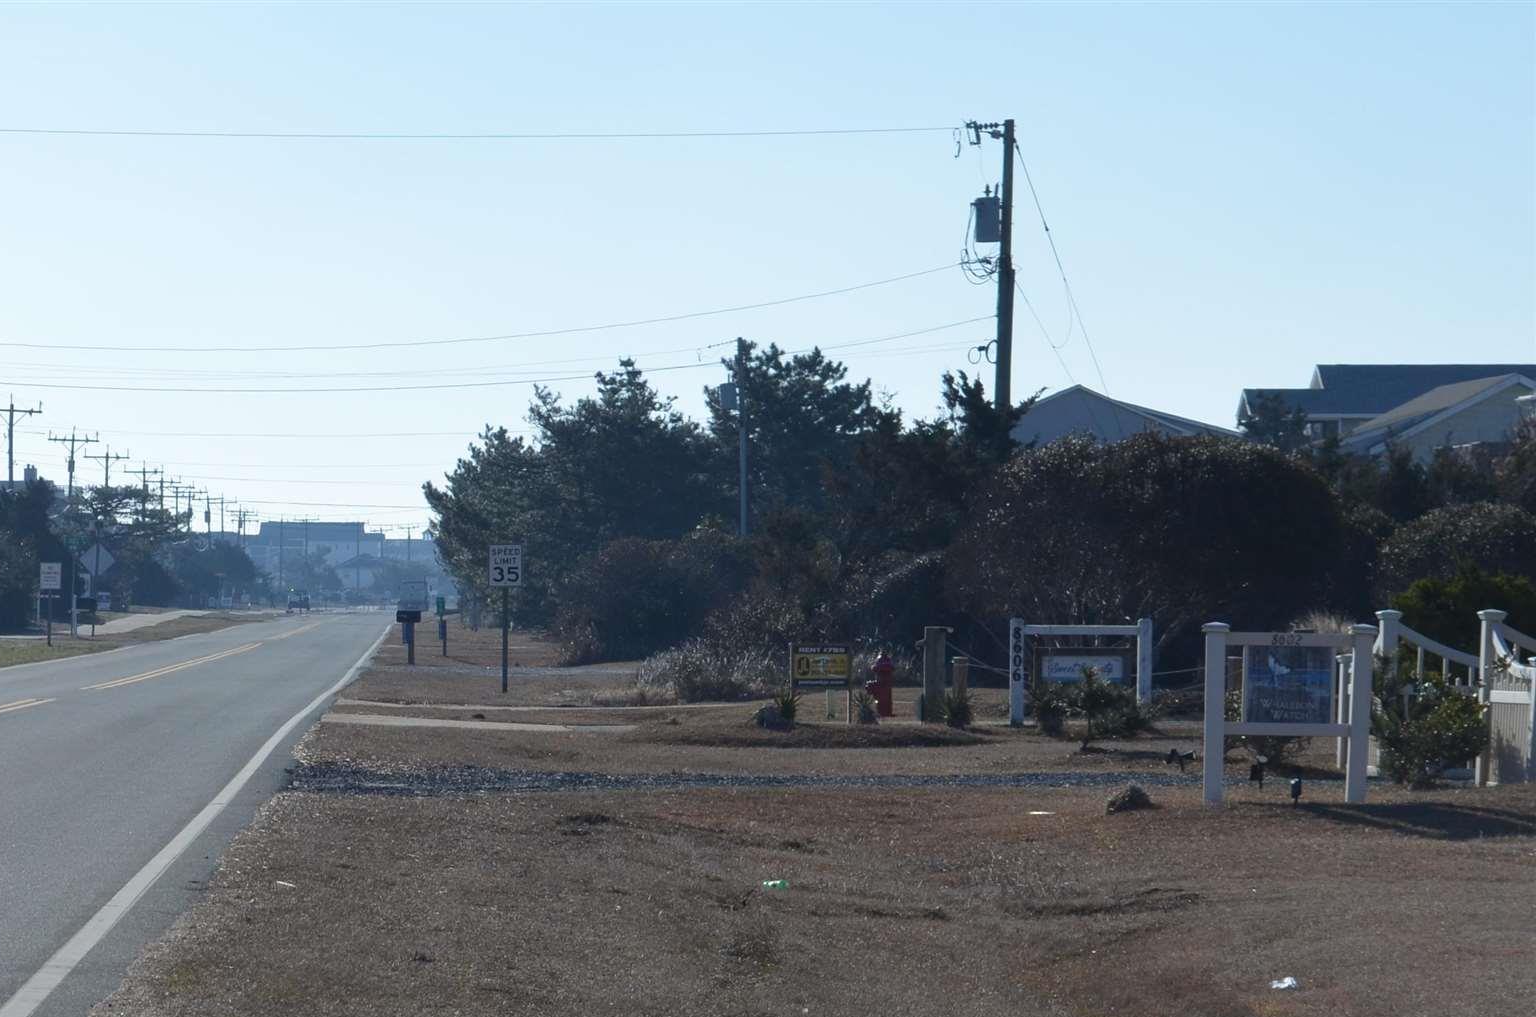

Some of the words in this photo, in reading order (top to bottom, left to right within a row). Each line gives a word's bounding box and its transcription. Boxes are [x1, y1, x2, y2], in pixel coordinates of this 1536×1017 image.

[491, 548, 521, 556] SPEED
[494, 557, 517, 565] LIMIT
[492, 566, 520, 583] 35
[1013, 627, 1023, 683] 8606
